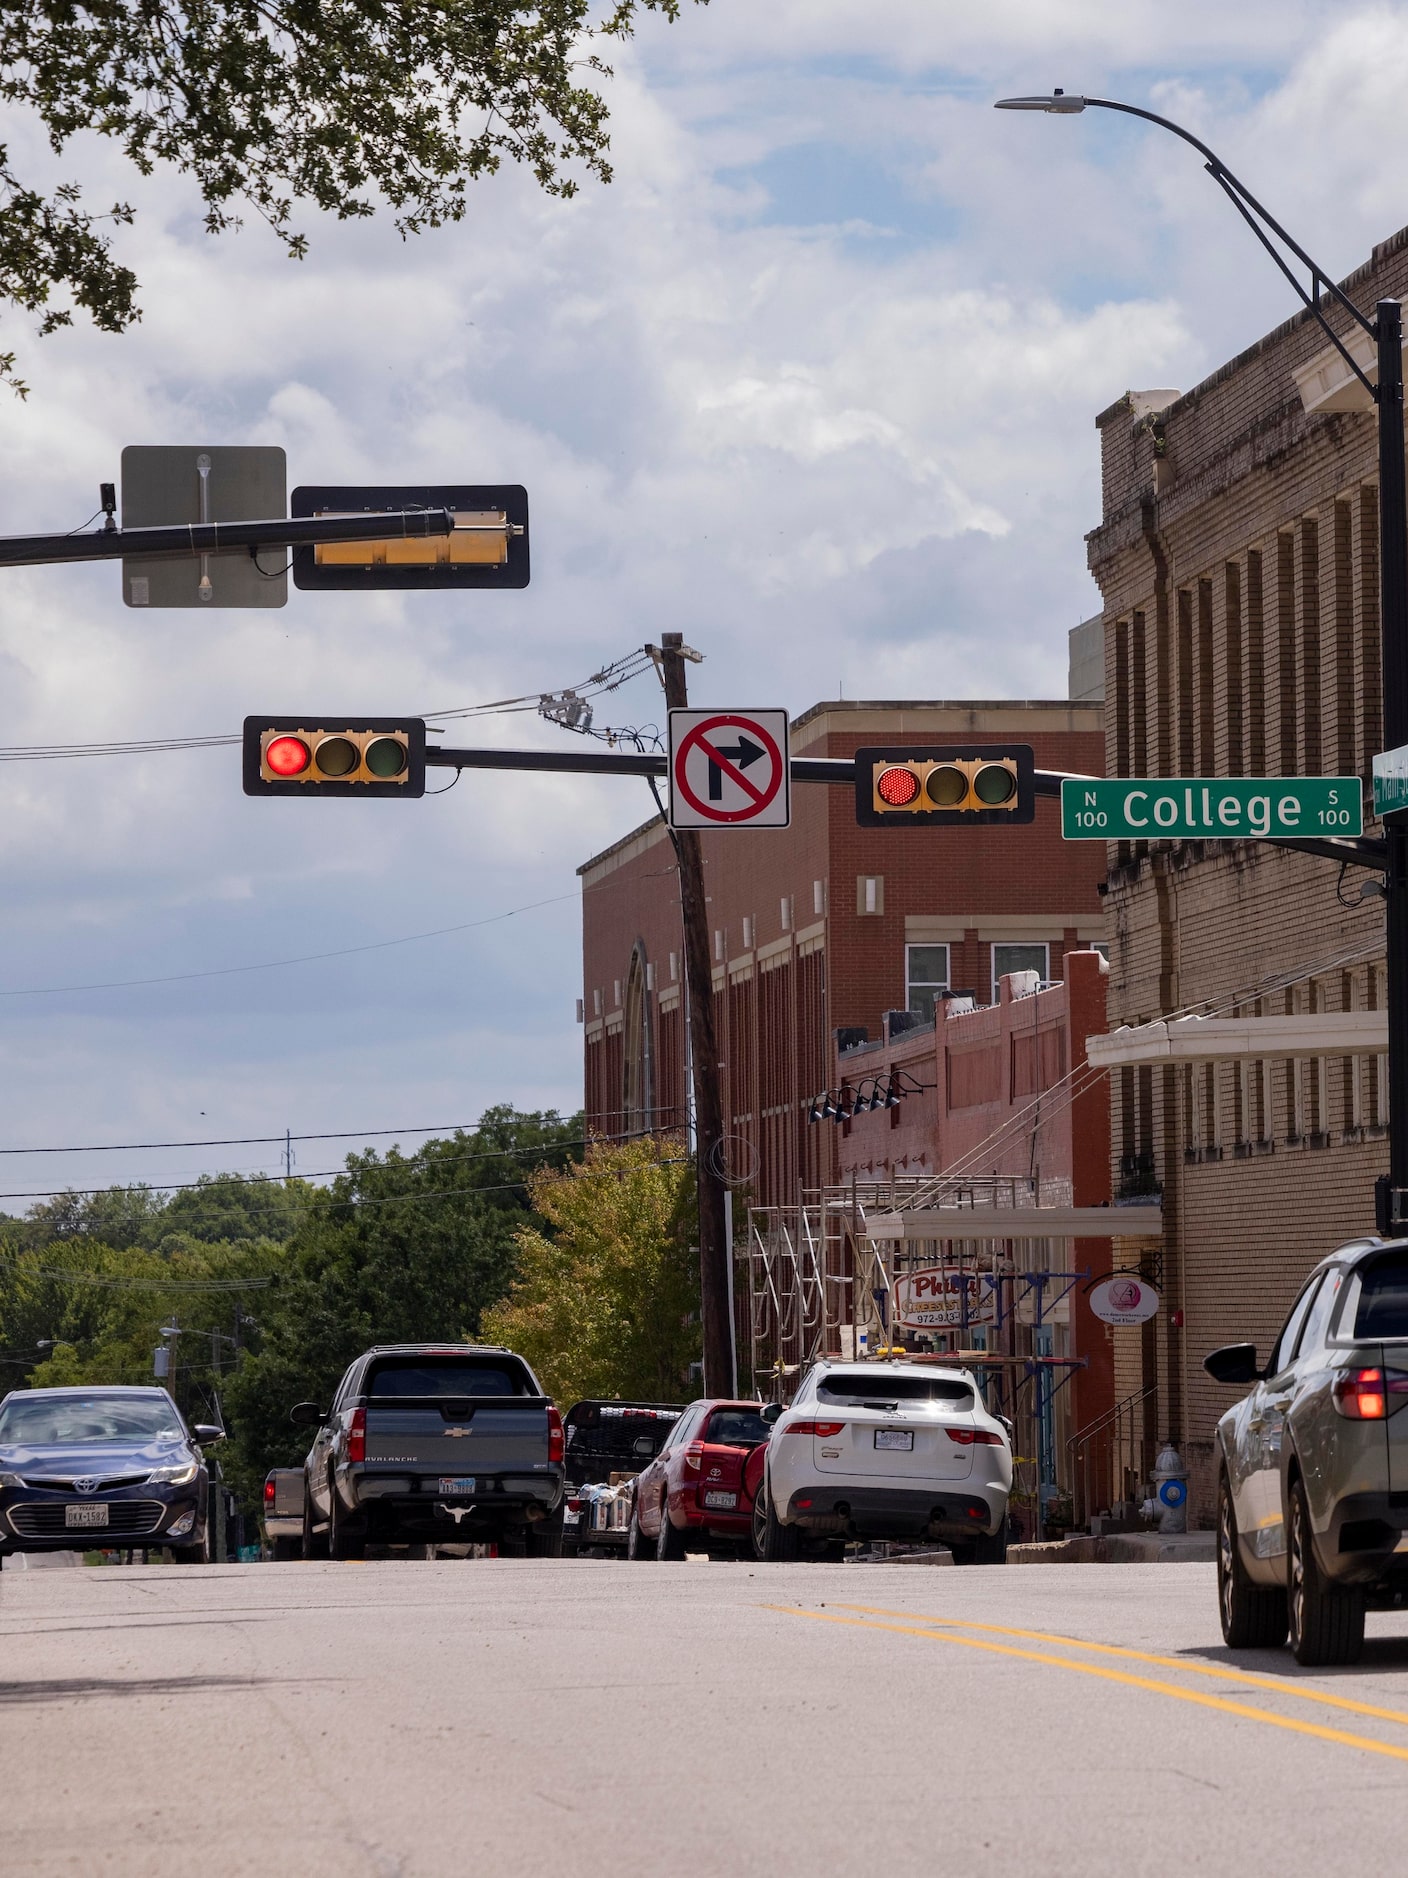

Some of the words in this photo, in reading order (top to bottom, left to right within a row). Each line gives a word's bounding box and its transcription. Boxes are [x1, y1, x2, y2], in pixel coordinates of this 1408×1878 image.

[1085, 791, 1097, 807] N
[1328, 789, 1339, 805] S
[1074, 811, 1108, 828] 100
[1123, 788, 1301, 836] College
[1317, 809, 1350, 826] 100
